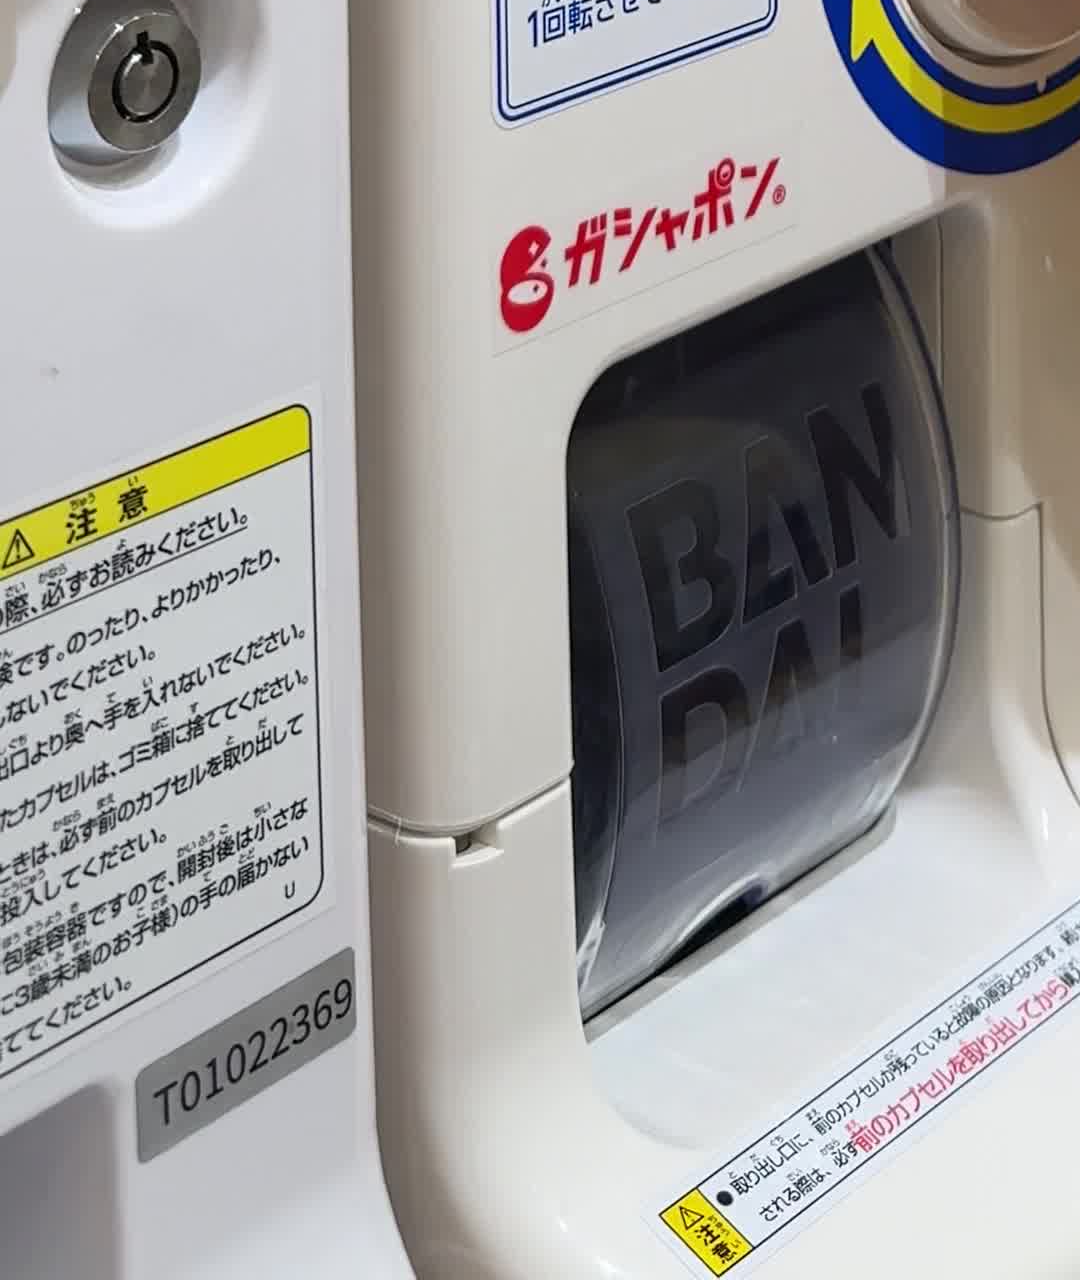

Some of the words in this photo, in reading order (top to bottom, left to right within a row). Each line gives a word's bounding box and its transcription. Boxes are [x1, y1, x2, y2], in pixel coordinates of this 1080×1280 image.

[65, 485, 149, 545] 注意
[626, 380, 912, 674] BAN
[0, 827, 168, 928] 投入してください。
[283, 881, 297, 902] U
[0, 976, 133, 1056] ててください。
[152, 977, 354, 1128] T01022369
[693, 1222, 738, 1265] 注意
